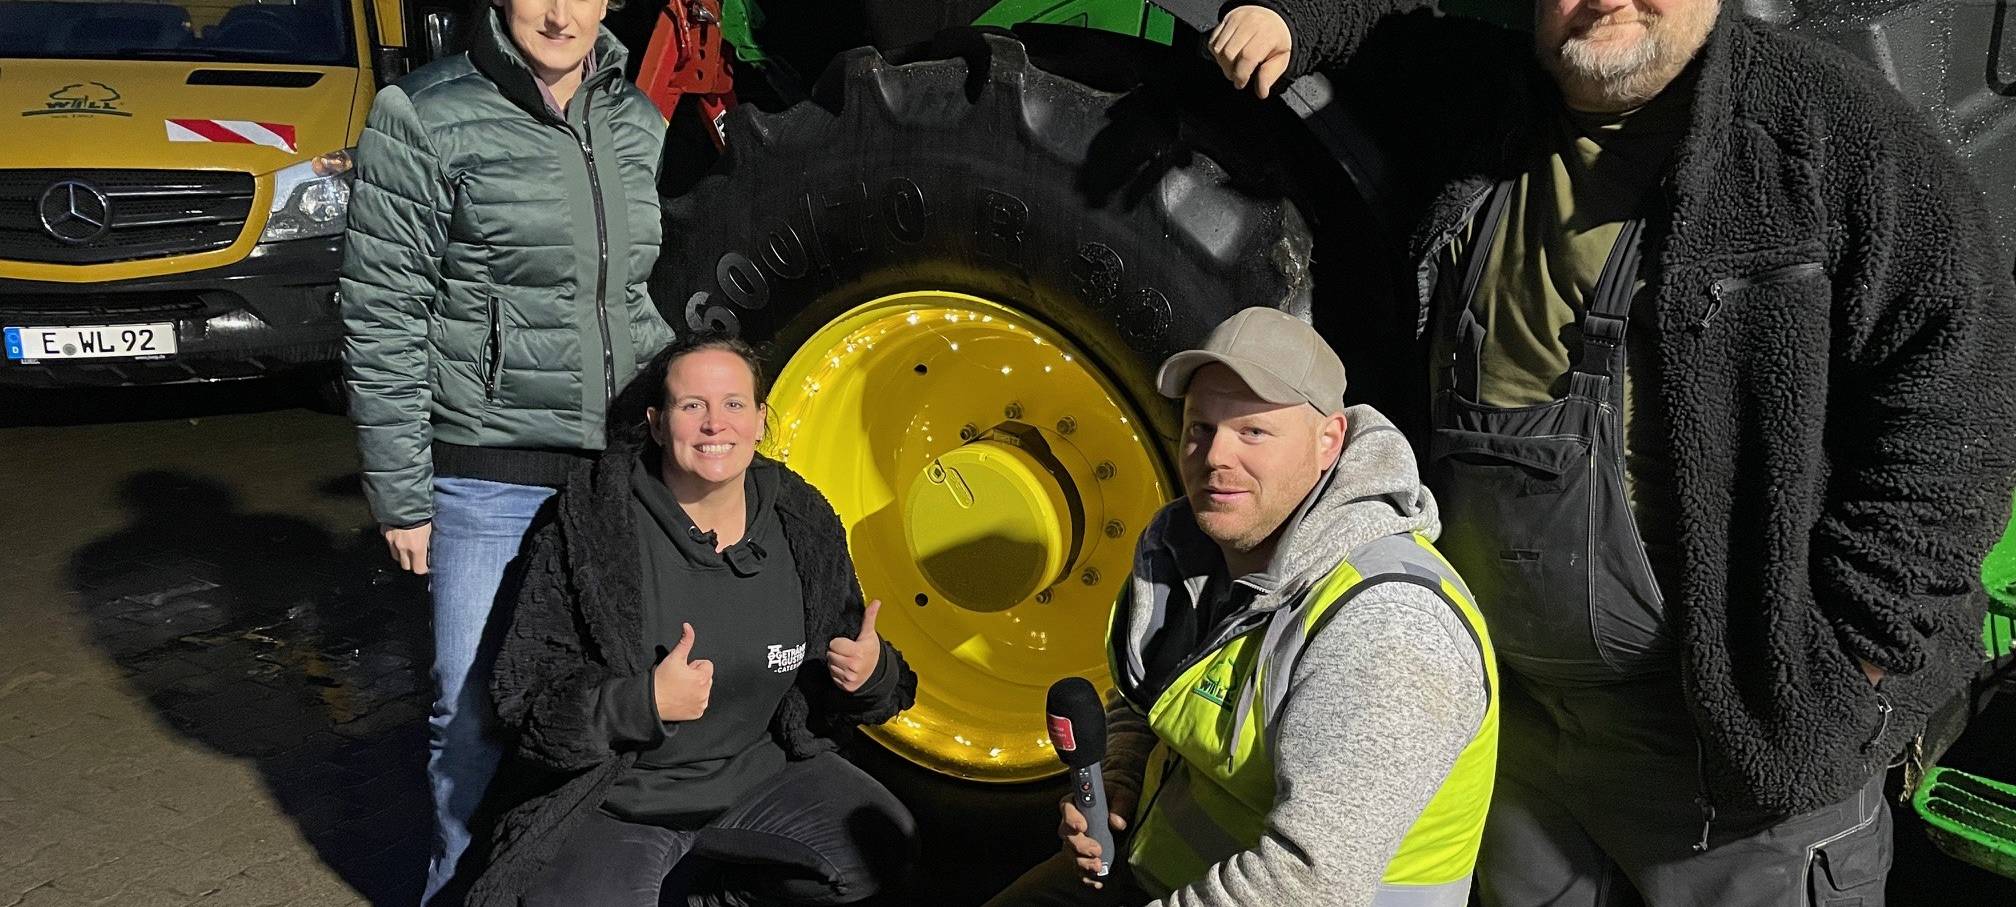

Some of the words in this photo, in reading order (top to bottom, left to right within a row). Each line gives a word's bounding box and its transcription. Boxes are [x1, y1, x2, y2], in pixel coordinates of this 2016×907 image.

[42, 332, 60, 354] E
[79, 331, 115, 353] WL
[121, 329, 156, 351] 92
